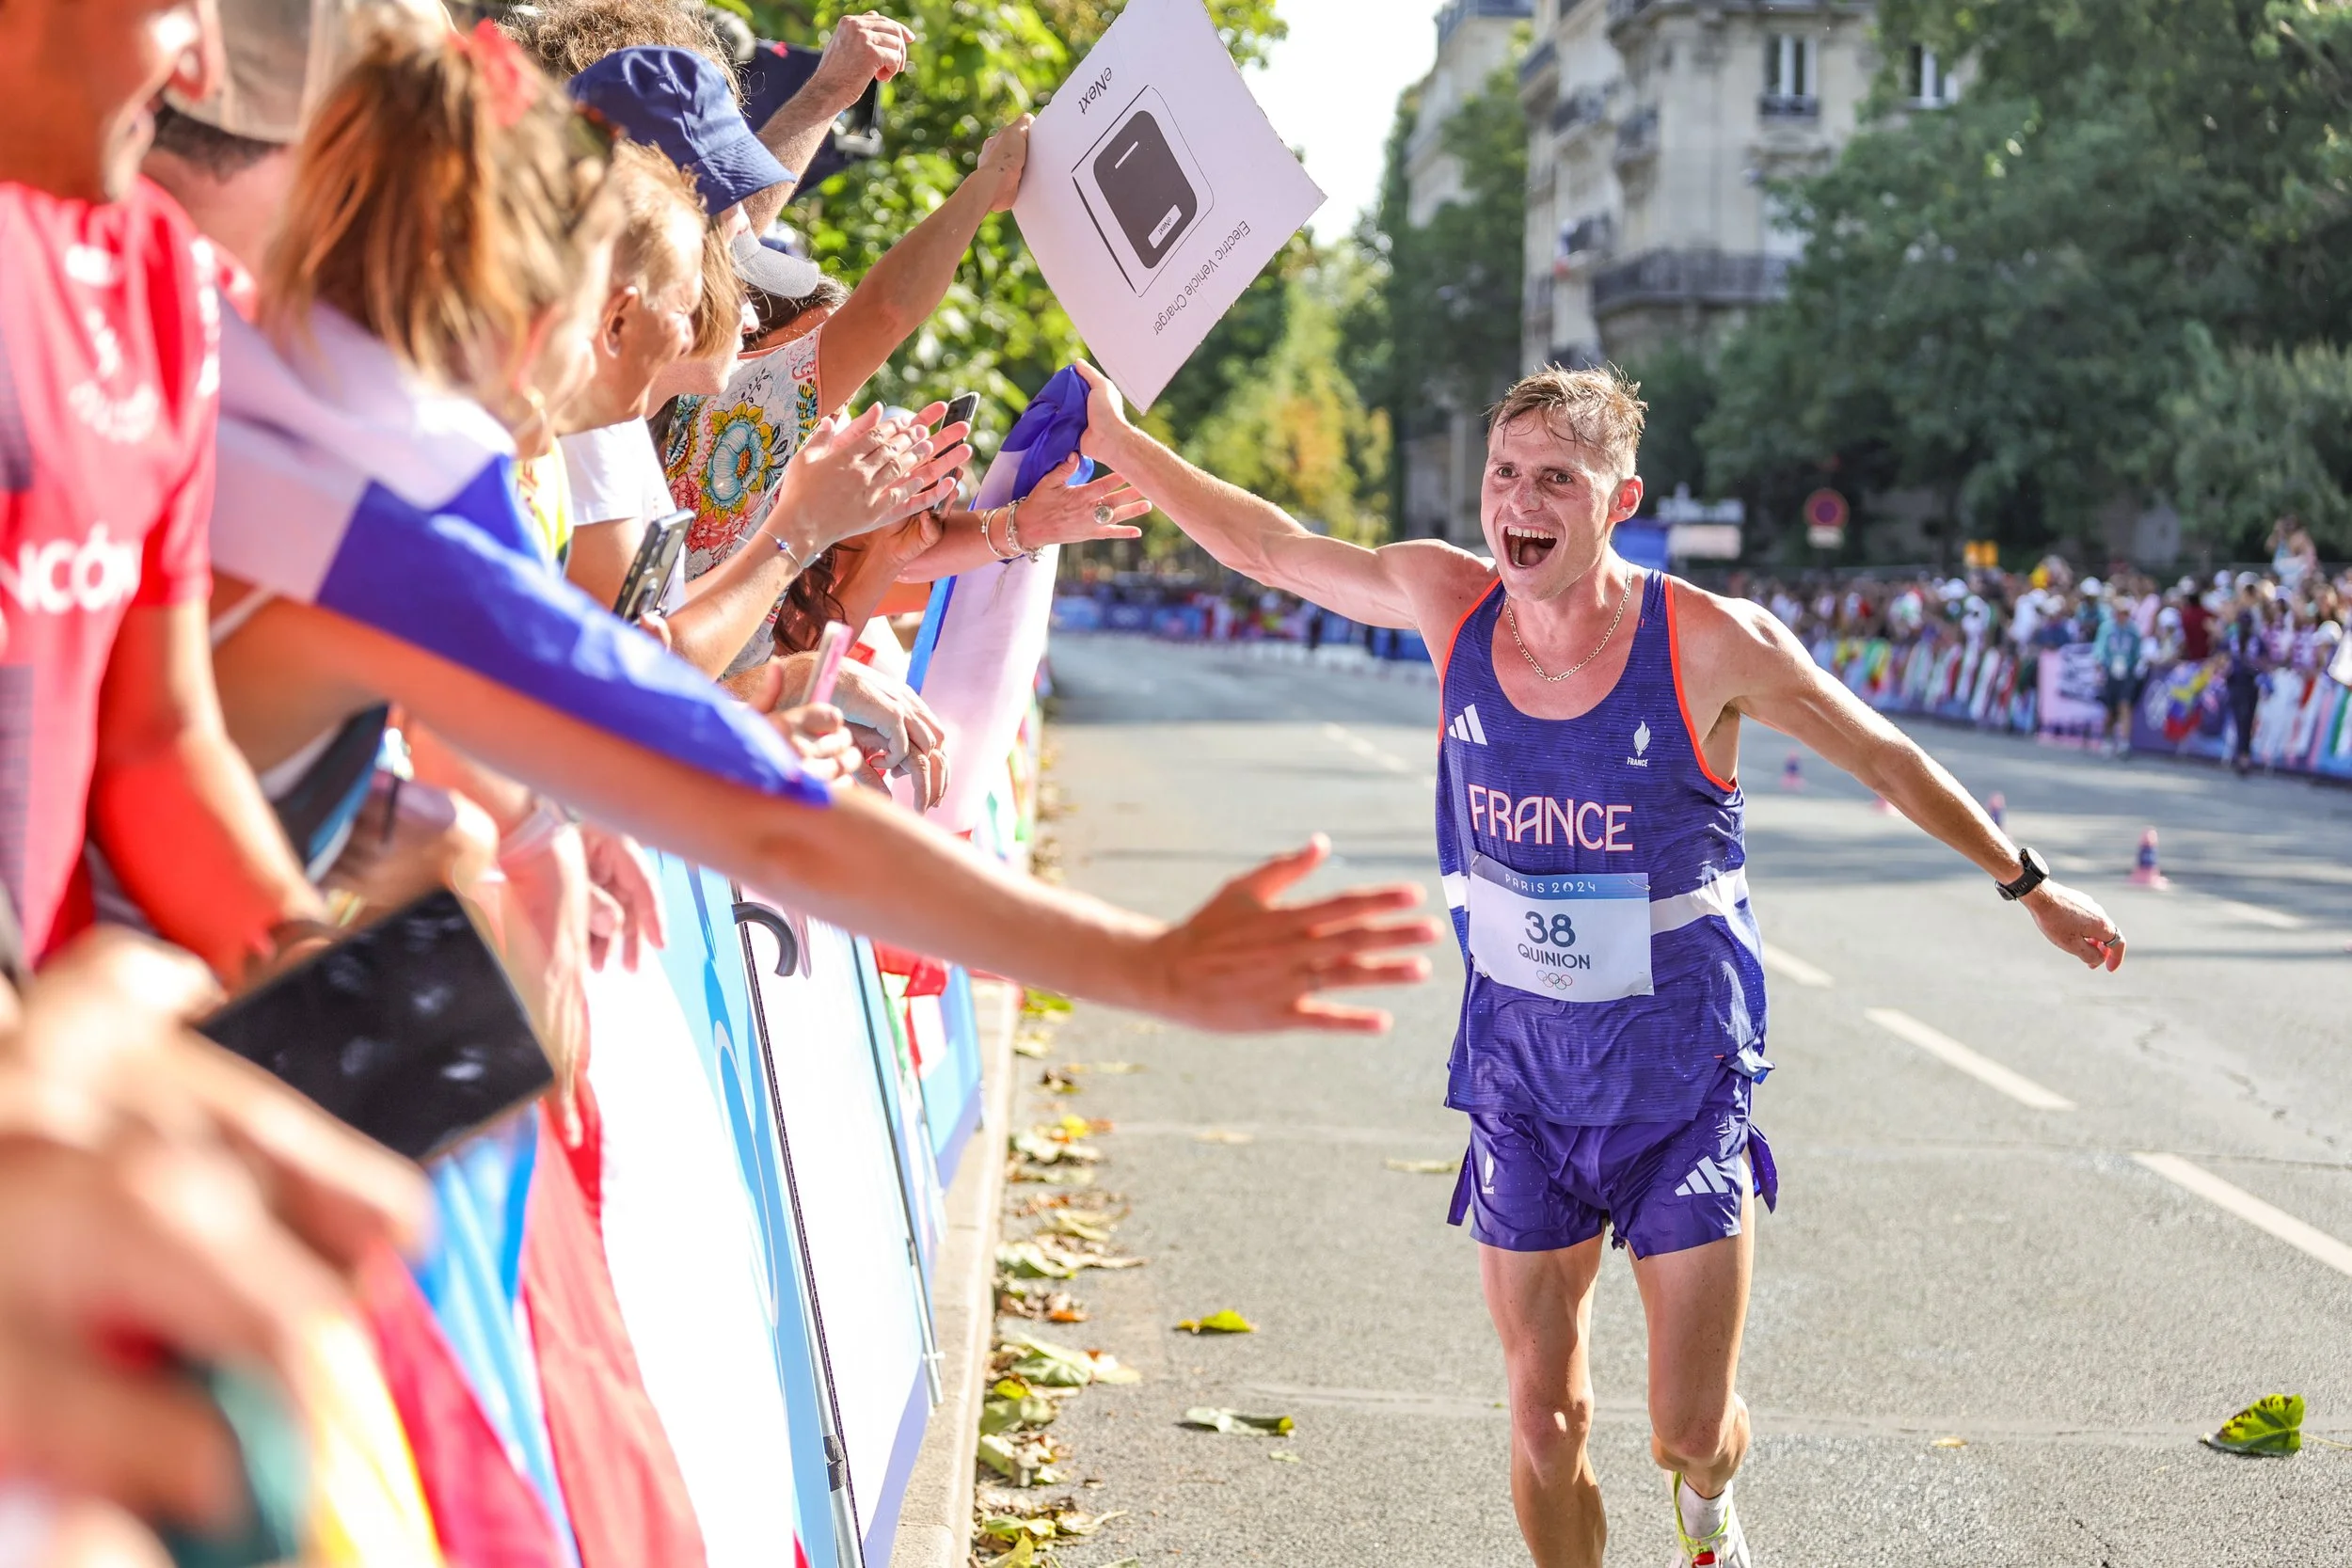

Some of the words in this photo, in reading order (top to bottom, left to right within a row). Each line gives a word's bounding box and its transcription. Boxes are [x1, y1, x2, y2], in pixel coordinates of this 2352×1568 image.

[1078, 67, 1113, 116] eNext
[1158, 216, 1172, 235] eNext
[1215, 220, 1251, 261] Electric
[1184, 259, 1219, 296] Vehicle
[1153, 293, 1187, 337] Charger
[1627, 756, 1648, 768] FRANCE
[1468, 784, 1633, 851] FRANCE
[1552, 880, 1597, 893] 2024
[1525, 911, 1576, 948] 38
[1518, 943, 1591, 970] QUINION
